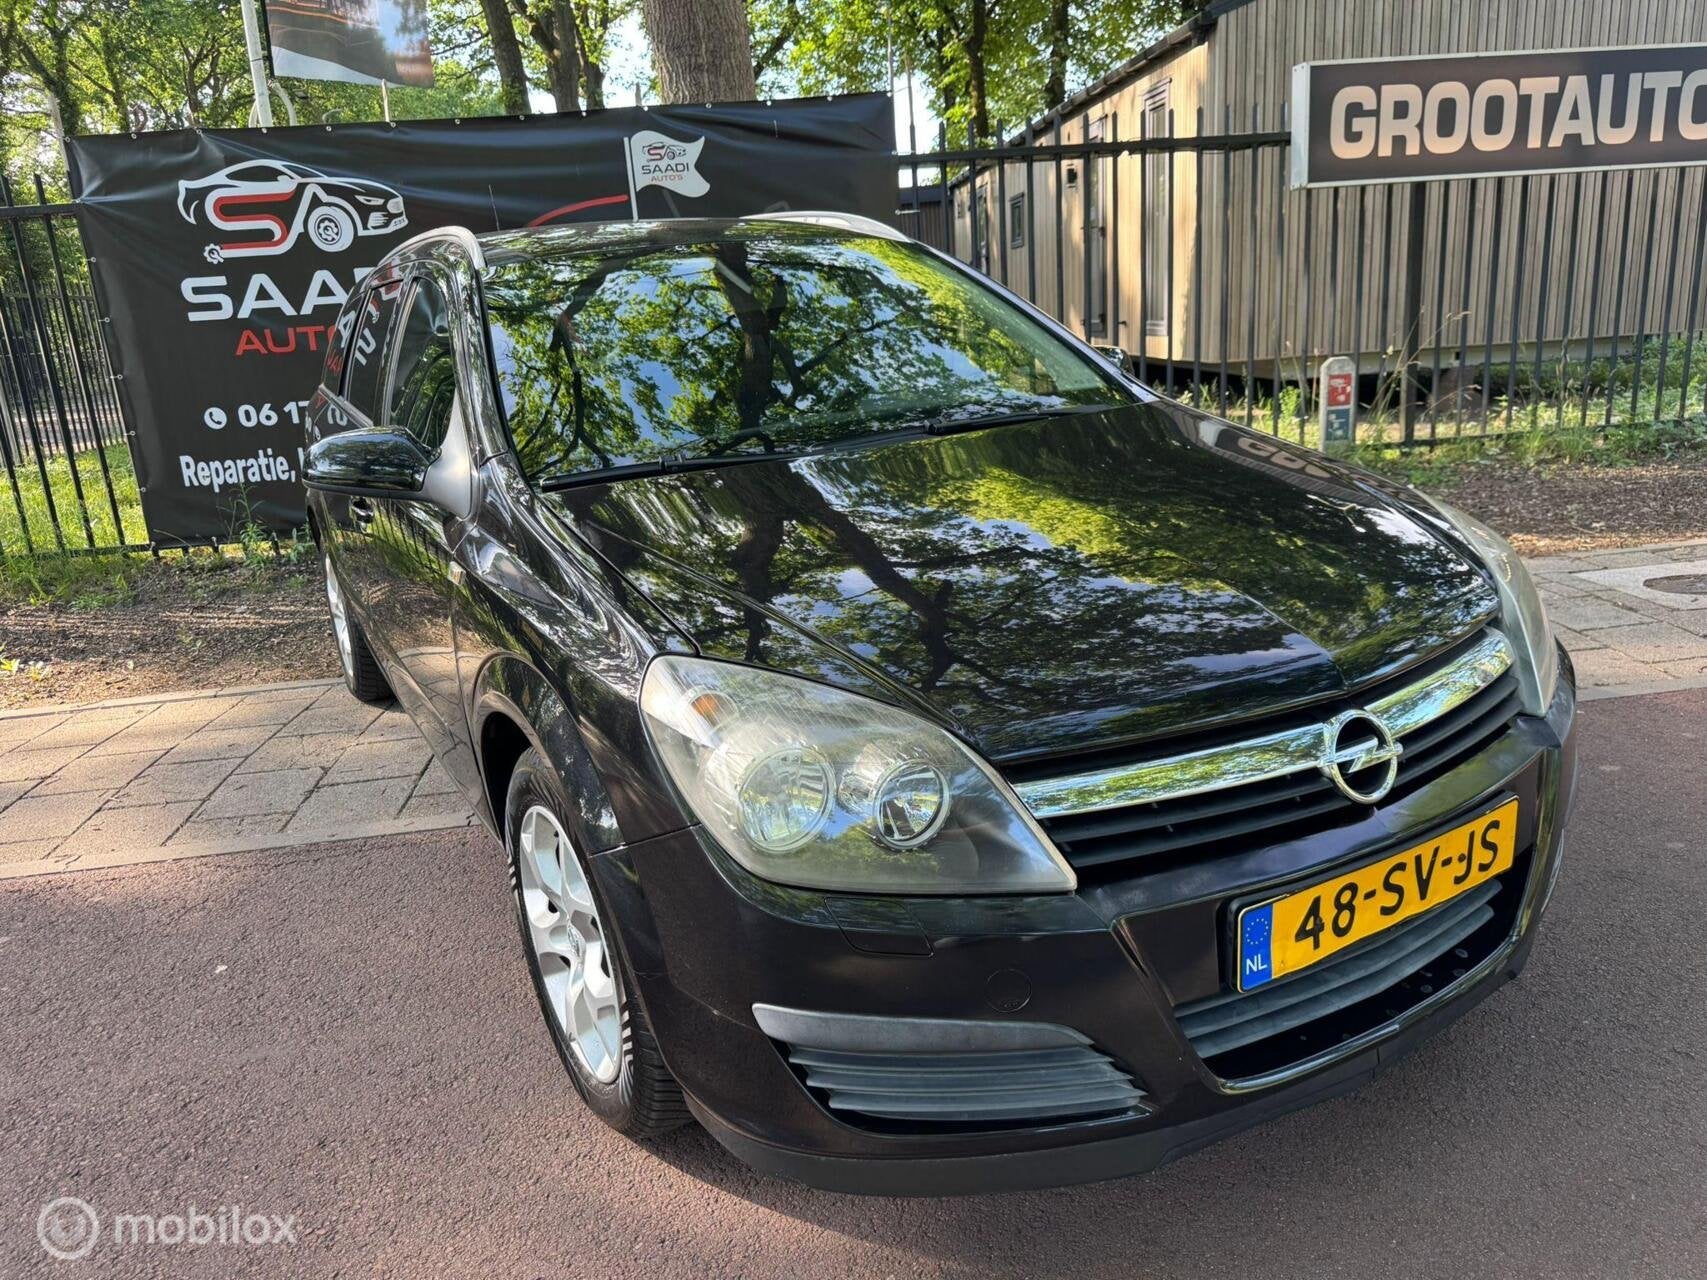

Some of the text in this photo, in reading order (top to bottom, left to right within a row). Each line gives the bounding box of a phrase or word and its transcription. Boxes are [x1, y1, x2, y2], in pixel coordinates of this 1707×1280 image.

[641, 162, 690, 175] SAADI
[237, 403, 279, 428] 06
[179, 447, 296, 493] Reparatie,
[1294, 819, 1501, 950] 48-SV-JS
[1245, 953, 1268, 976] NL
